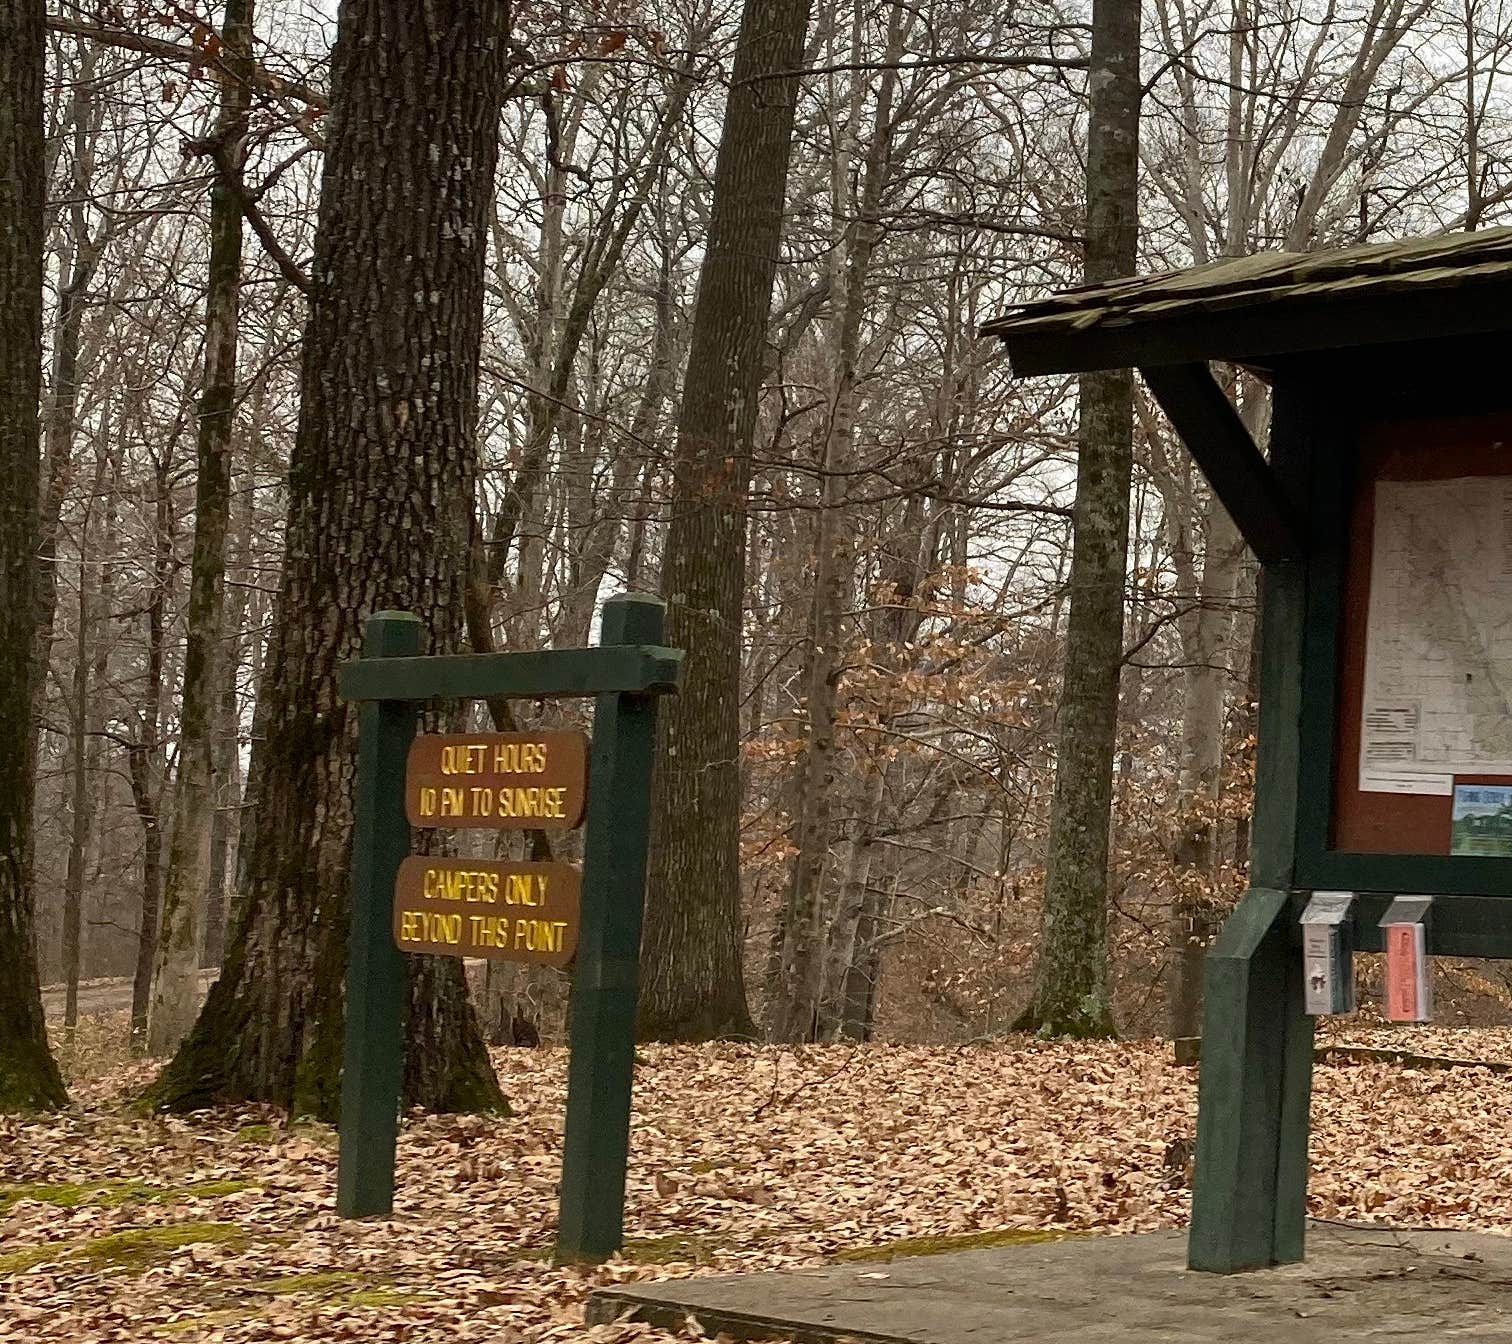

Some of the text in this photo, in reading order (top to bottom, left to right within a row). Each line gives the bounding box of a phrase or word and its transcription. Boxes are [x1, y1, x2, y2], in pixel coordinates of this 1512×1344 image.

[441, 743, 547, 775] QUIET HOURS
[420, 787, 568, 818] 10 PM TO SUNRISE
[423, 869, 549, 906] CAMPERS ONLY
[401, 911, 568, 952] BEYOND THIS POINT
